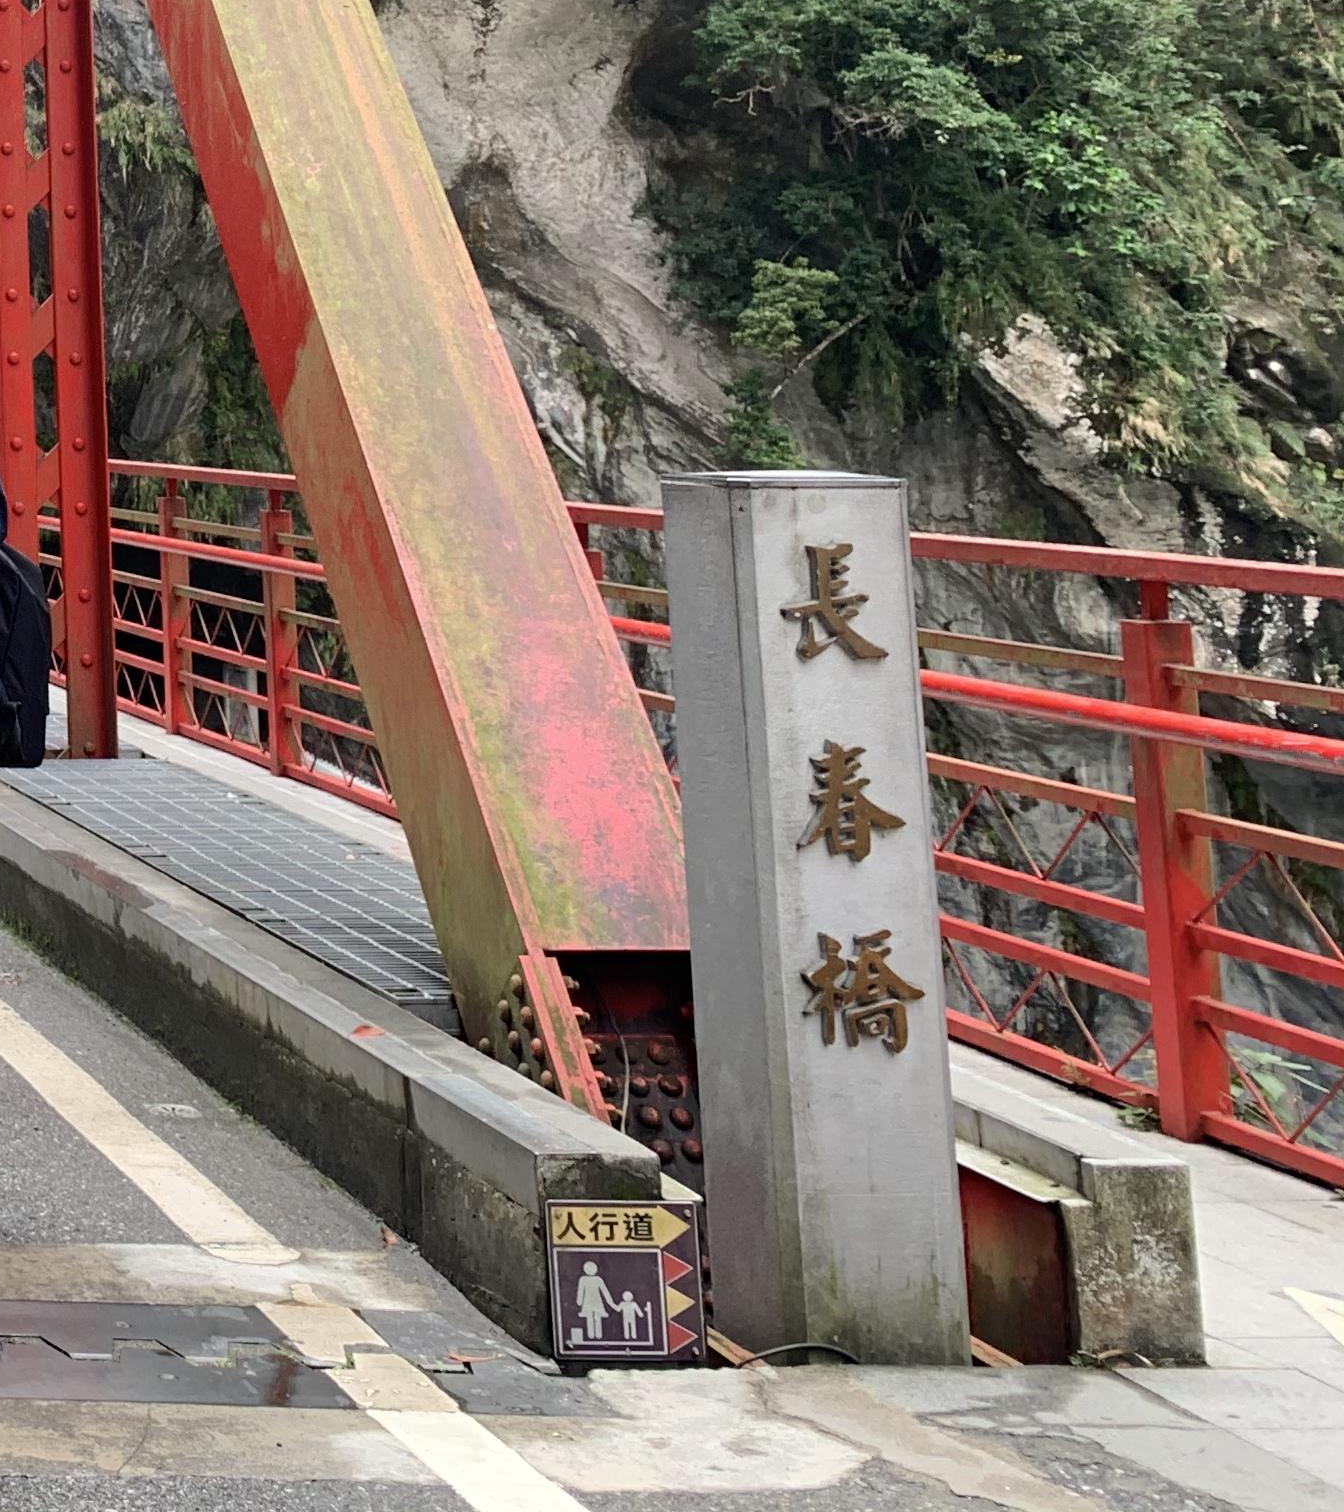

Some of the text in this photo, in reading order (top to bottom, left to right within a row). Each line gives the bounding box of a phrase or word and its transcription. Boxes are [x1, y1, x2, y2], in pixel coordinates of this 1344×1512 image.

[779, 542, 926, 1054] 長春橋
[557, 1211, 655, 1242] 人行道
